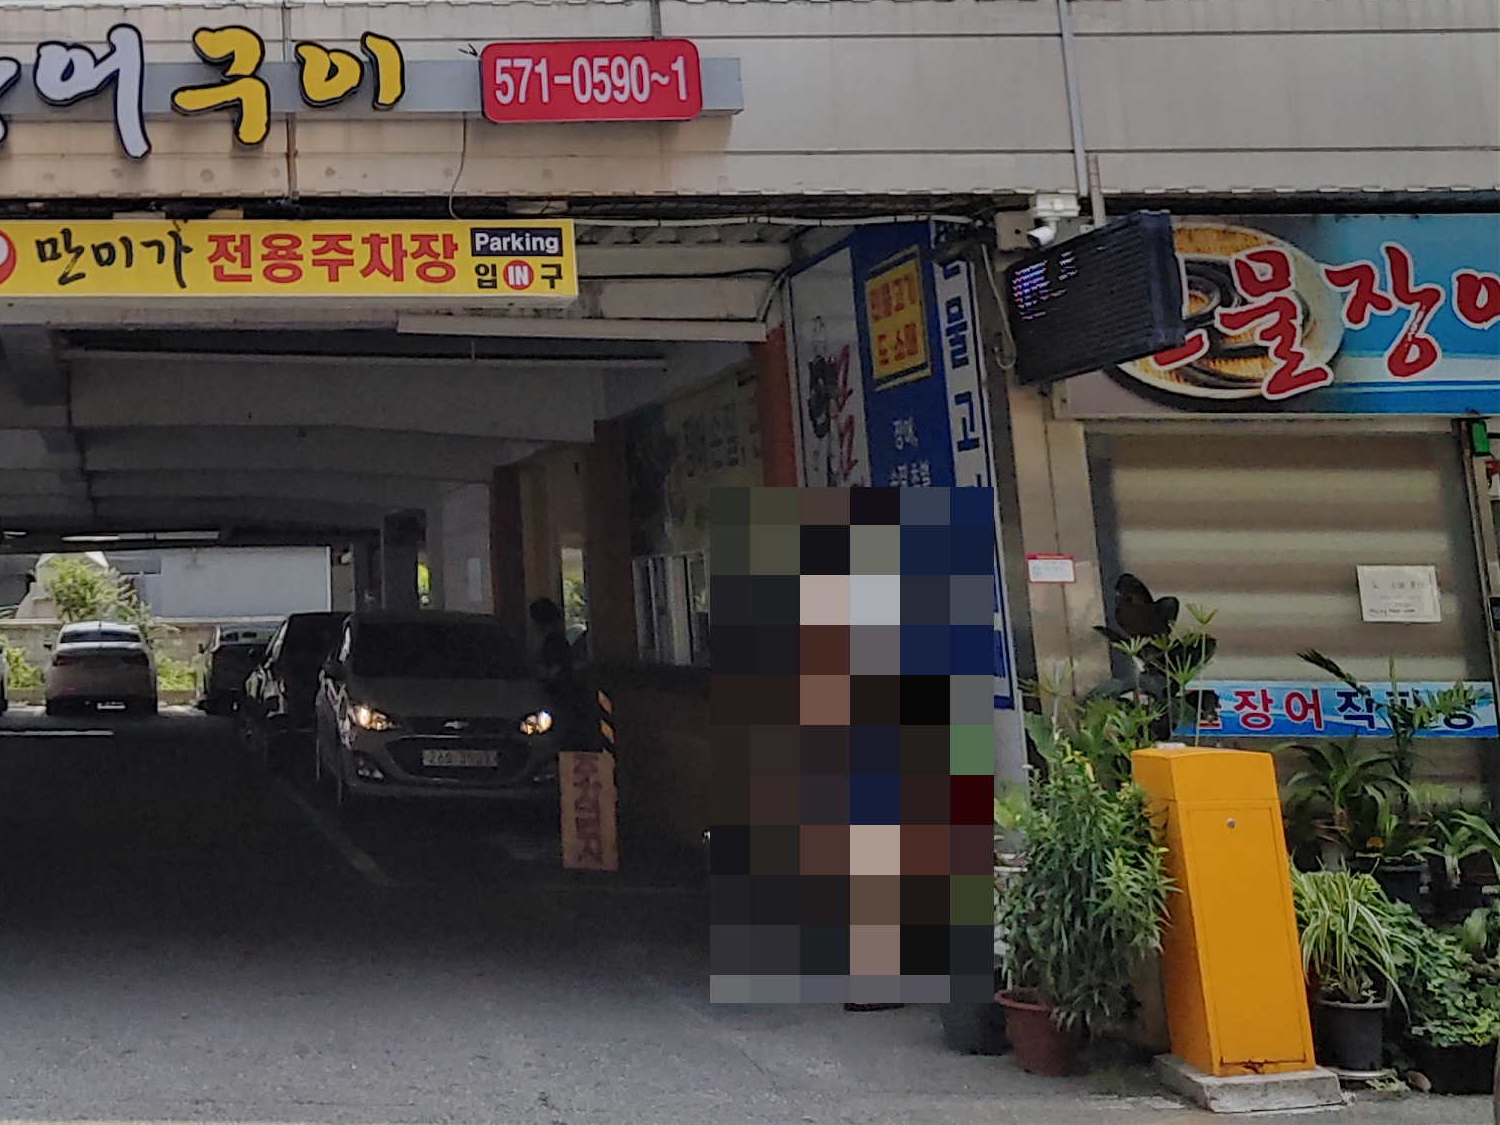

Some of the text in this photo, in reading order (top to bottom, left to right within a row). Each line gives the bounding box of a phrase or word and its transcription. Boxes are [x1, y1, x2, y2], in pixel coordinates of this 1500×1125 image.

[171, 25, 405, 148] 구이
[496, 55, 688, 105] 571-0590~1
[36, 229, 459, 288] 만미가 전용주차장
[474, 232, 559, 254] Parking
[507, 264, 530, 286] IN
[1154, 244, 1500, 398] 물장
